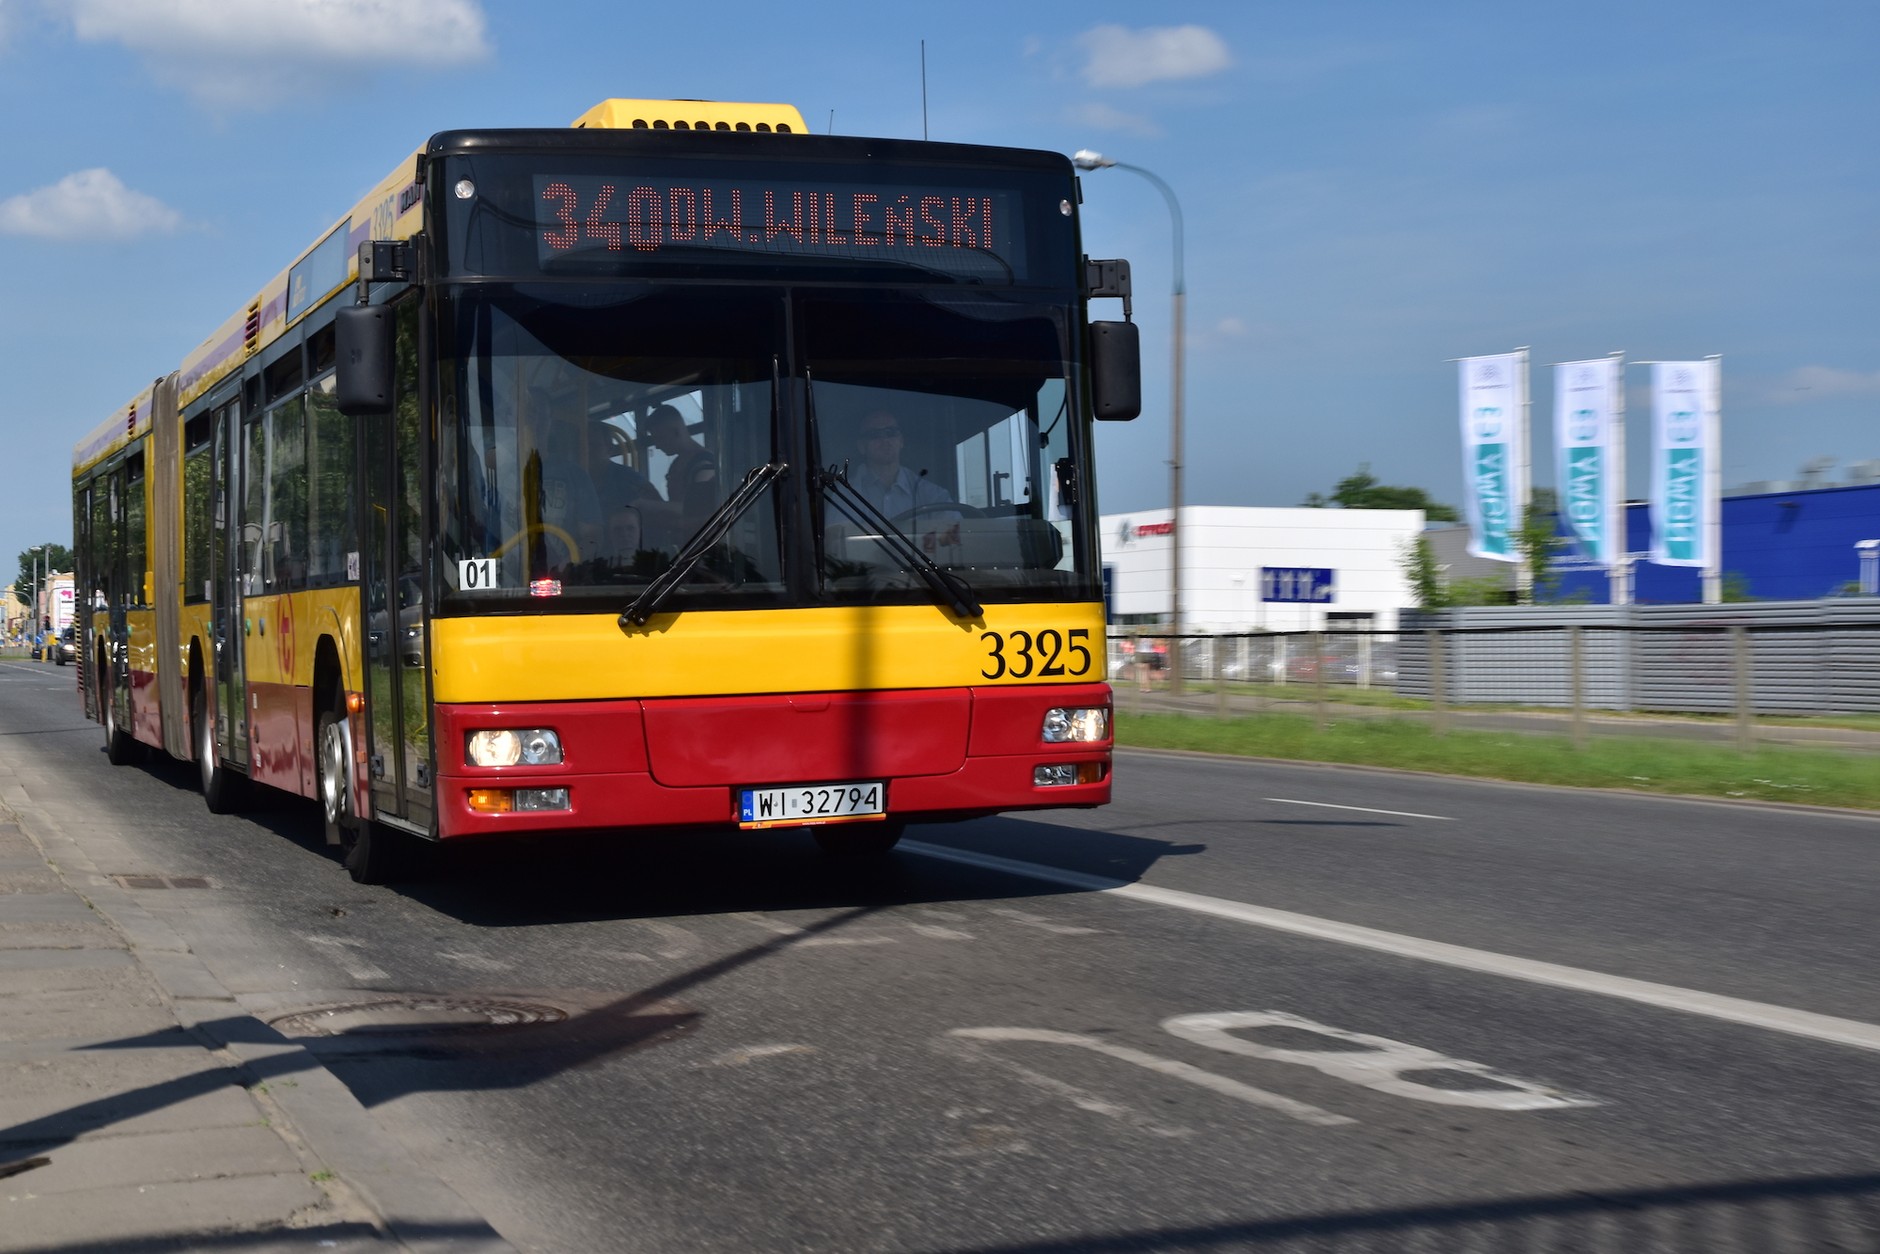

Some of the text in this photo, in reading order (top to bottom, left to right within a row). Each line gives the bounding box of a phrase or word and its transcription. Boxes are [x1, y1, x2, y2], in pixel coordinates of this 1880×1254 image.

[541, 182, 663, 252] 340
[466, 560, 490, 588] 01
[980, 629, 1091, 679] 3325
[743, 808, 753, 816] PL
[759, 786, 878, 817] WI 32794
